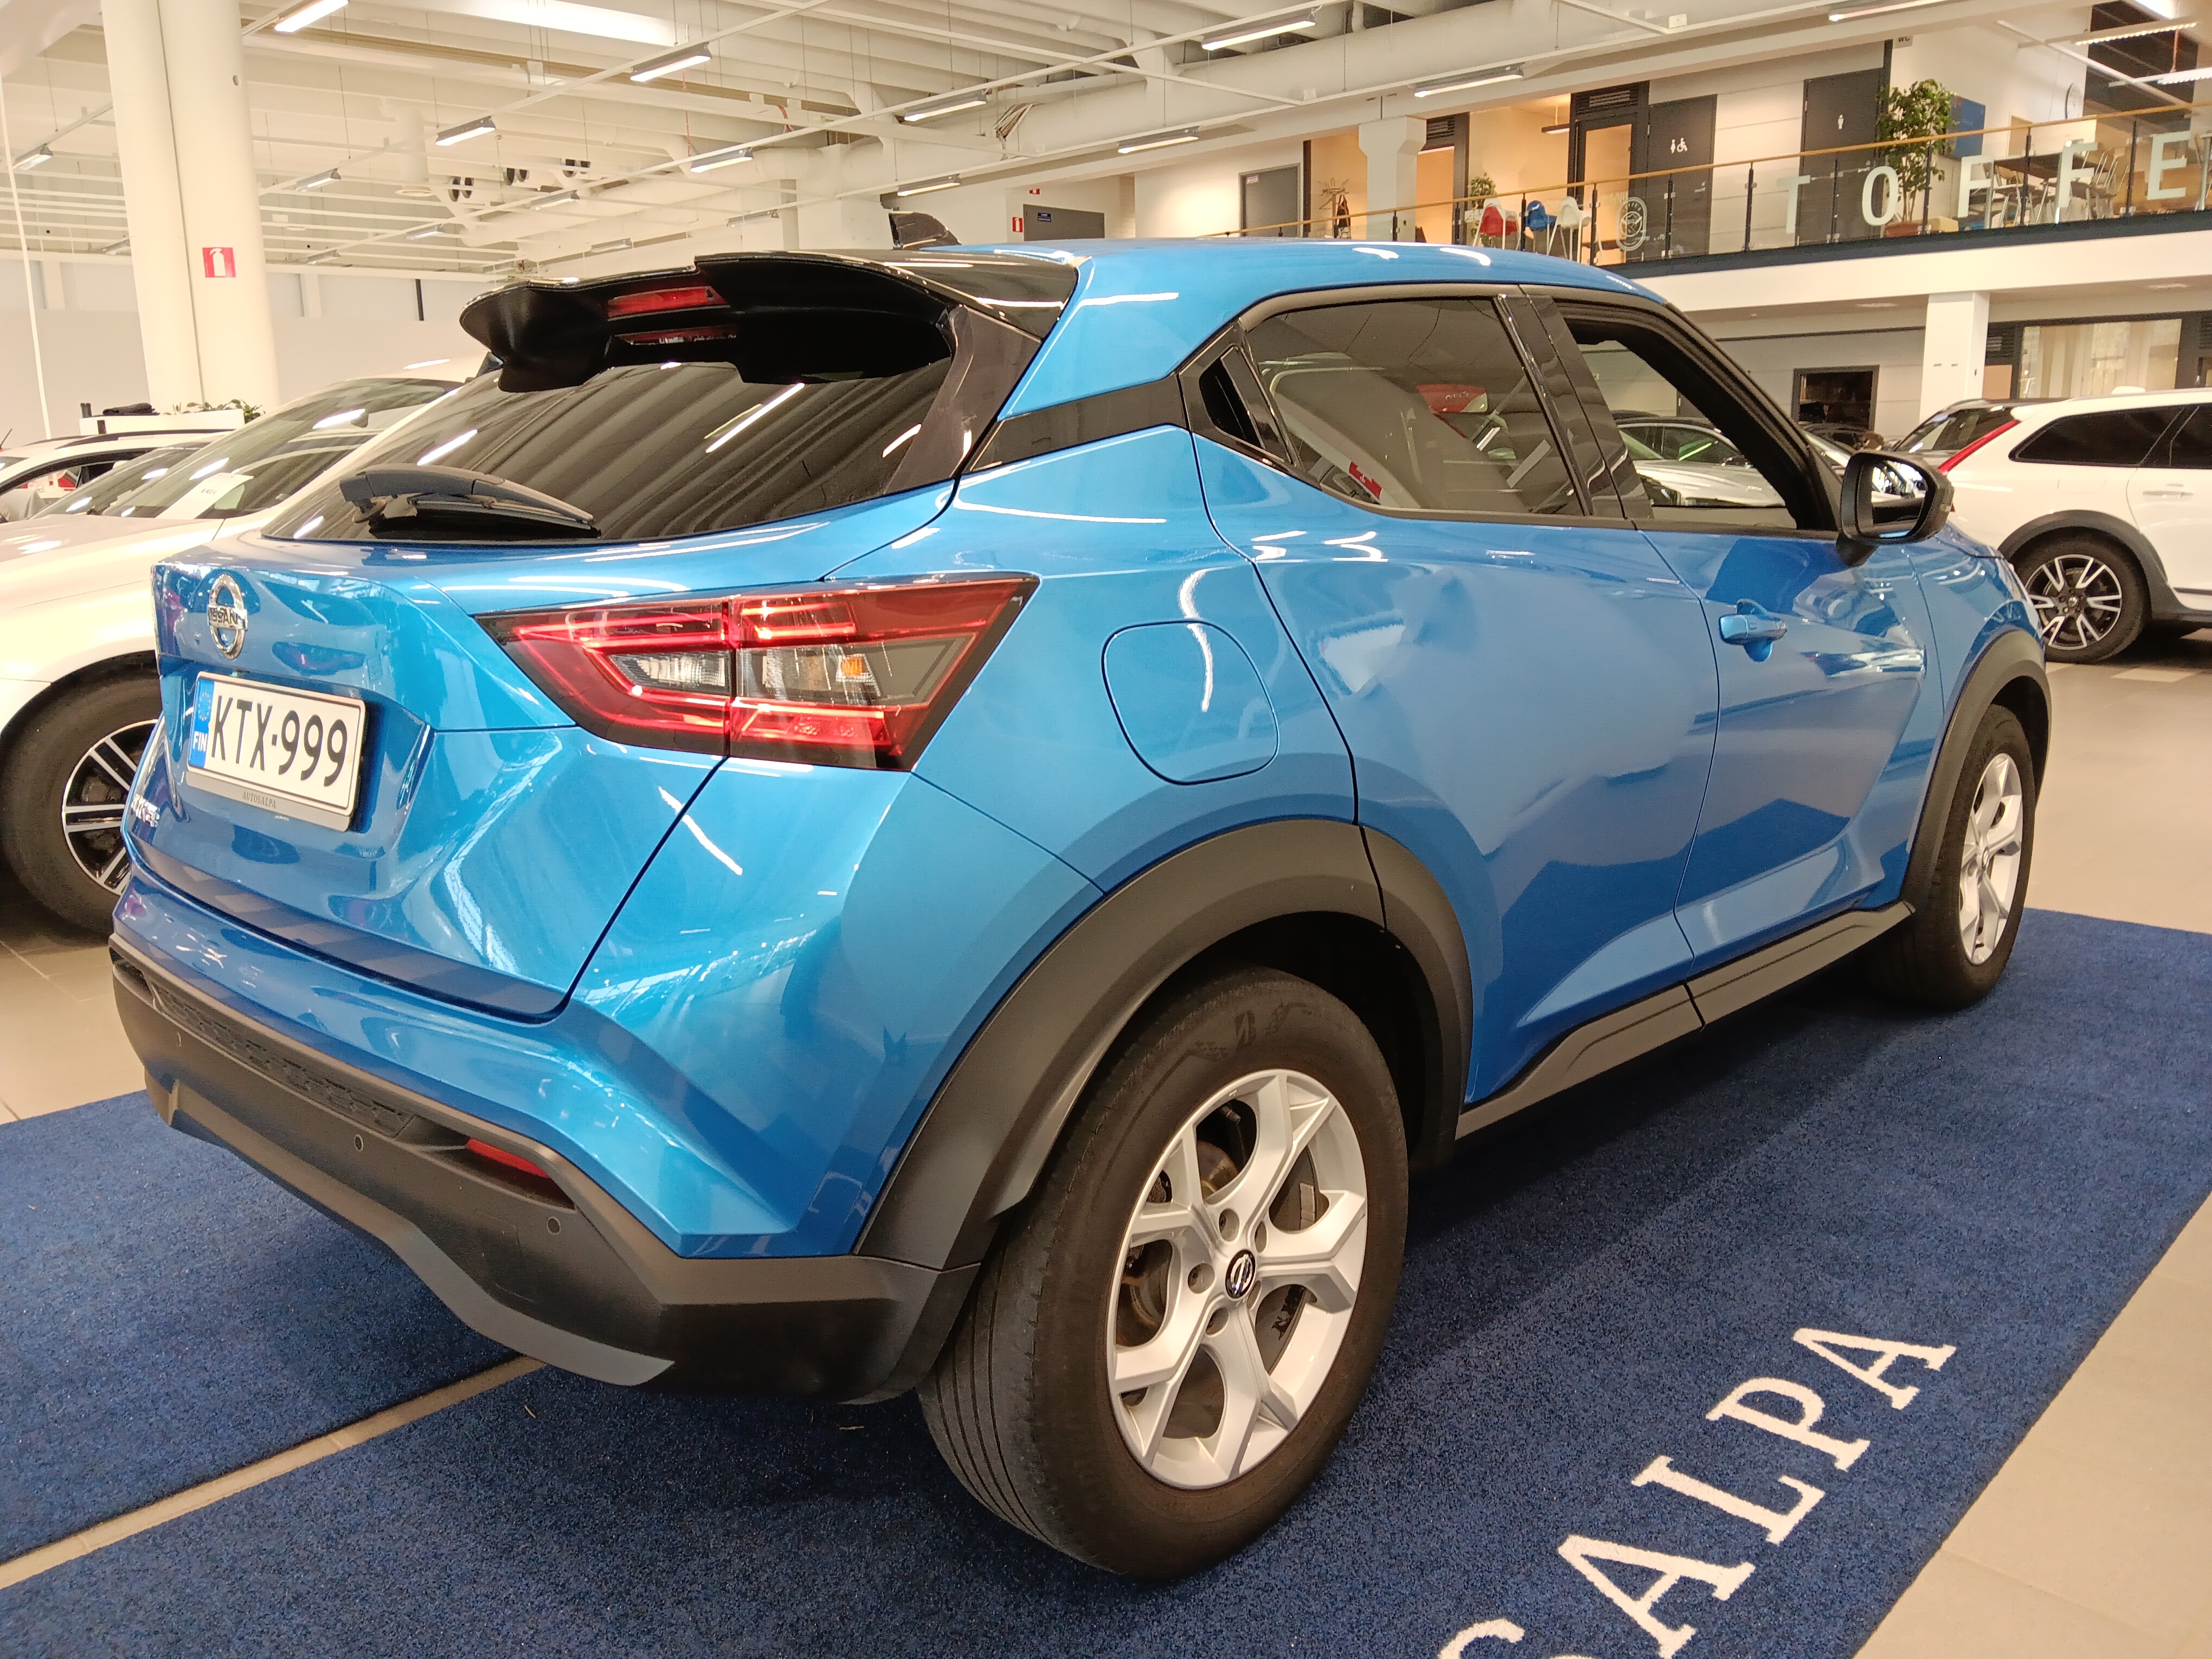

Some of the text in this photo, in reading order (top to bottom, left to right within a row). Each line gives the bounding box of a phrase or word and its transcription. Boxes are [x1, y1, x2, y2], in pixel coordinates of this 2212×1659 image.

[208, 607, 239, 625] NISSAN
[192, 695, 348, 787] FIN KTX-999
[242, 791, 276, 808] AUTOSALPA
